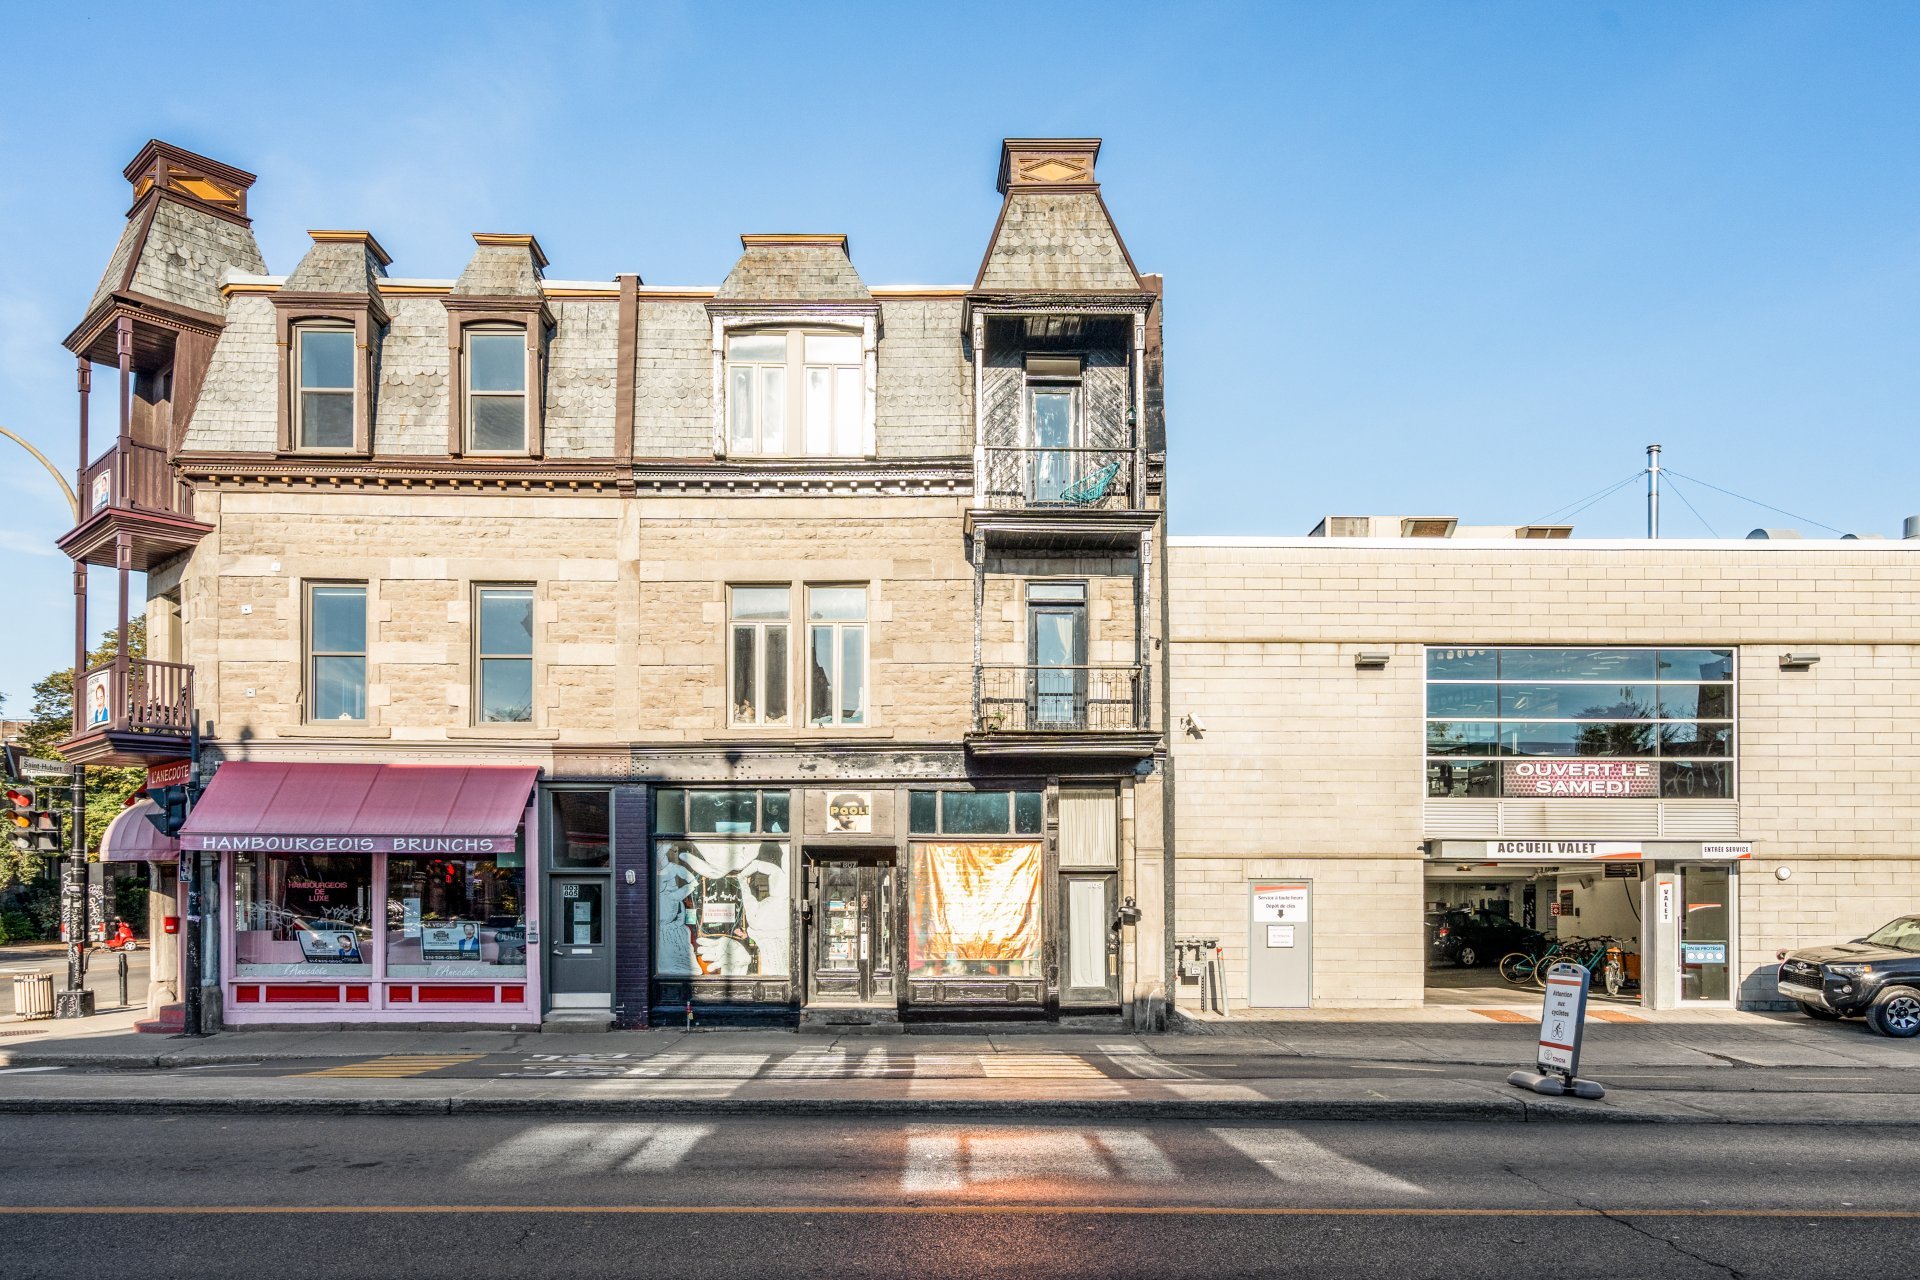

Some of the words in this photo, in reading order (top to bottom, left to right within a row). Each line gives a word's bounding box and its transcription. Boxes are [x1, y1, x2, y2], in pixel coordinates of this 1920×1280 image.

[23, 760, 62, 771] Saint-Hubert
[1515, 763, 1614, 776] OUVERT
[1622, 763, 1650, 777] LE
[151, 764, 189, 784] L'ANECDOTE
[1536, 781, 1630, 794] SAMEDI
[202, 837, 374, 851] HAMBOURGEOIS
[393, 838, 494, 852] BRUNCHS
[1497, 842, 1553, 853] ACCUEIL
[1557, 842, 1596, 853] VALET
[497, 931, 526, 940] OUVER
[1552, 990, 1572, 998] Attention
[1552, 1056, 1566, 1064] TOYOTA
